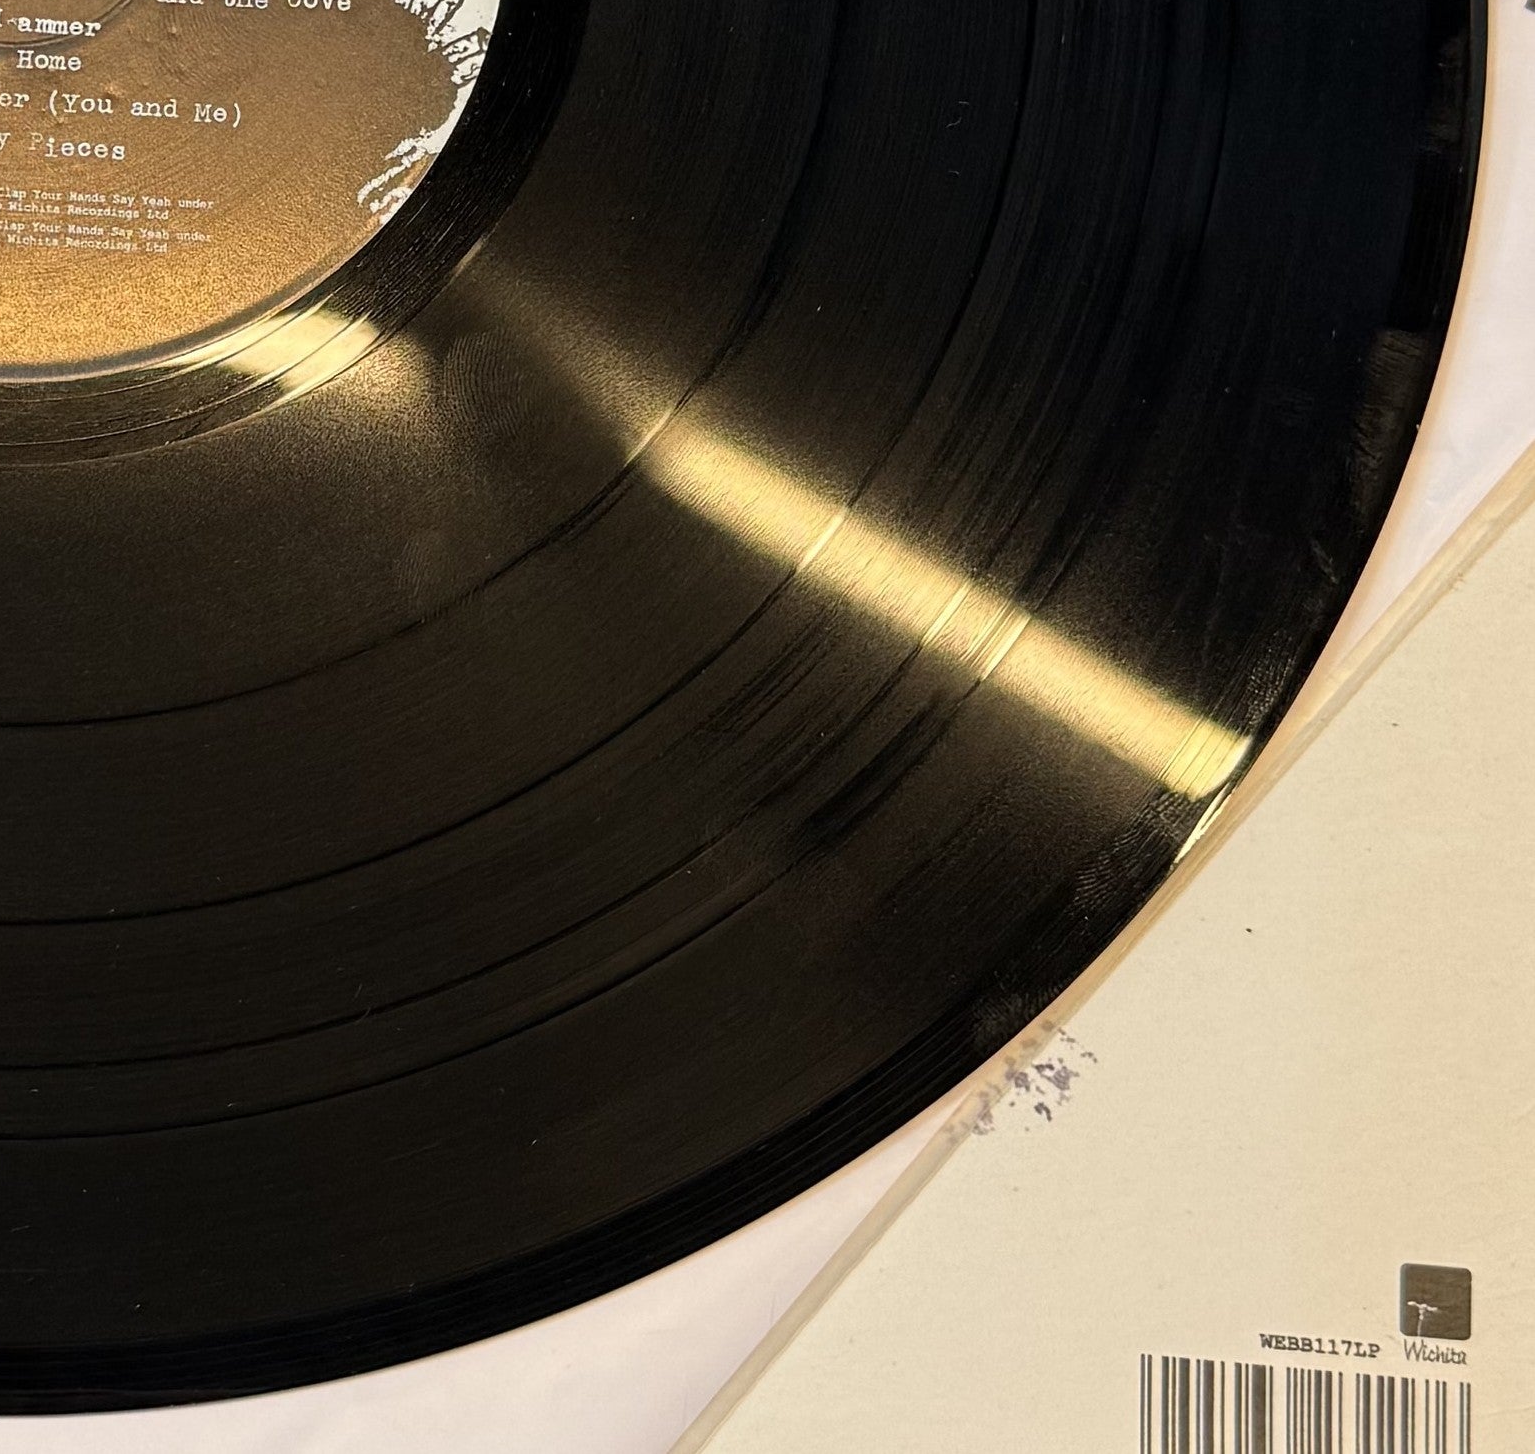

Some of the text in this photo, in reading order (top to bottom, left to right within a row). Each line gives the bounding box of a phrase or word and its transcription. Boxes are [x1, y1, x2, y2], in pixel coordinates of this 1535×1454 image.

[16, 50, 83, 72] Home
[48, 89, 113, 117] (You
[130, 99, 179, 119] and
[193, 102, 243, 128] Me)
[31, 131, 127, 161] Pieces
[8, 201, 60, 215] Wichita
[67, 204, 140, 221] Recordings
[33, 190, 63, 202] Your
[69, 192, 106, 204] Hands
[112, 195, 135, 208] Say
[141, 196, 171, 208] Yeah
[178, 199, 215, 210] under
[1259, 1333, 1381, 1360] WEBB117LP
[1403, 1339, 1468, 1366] Wichita
